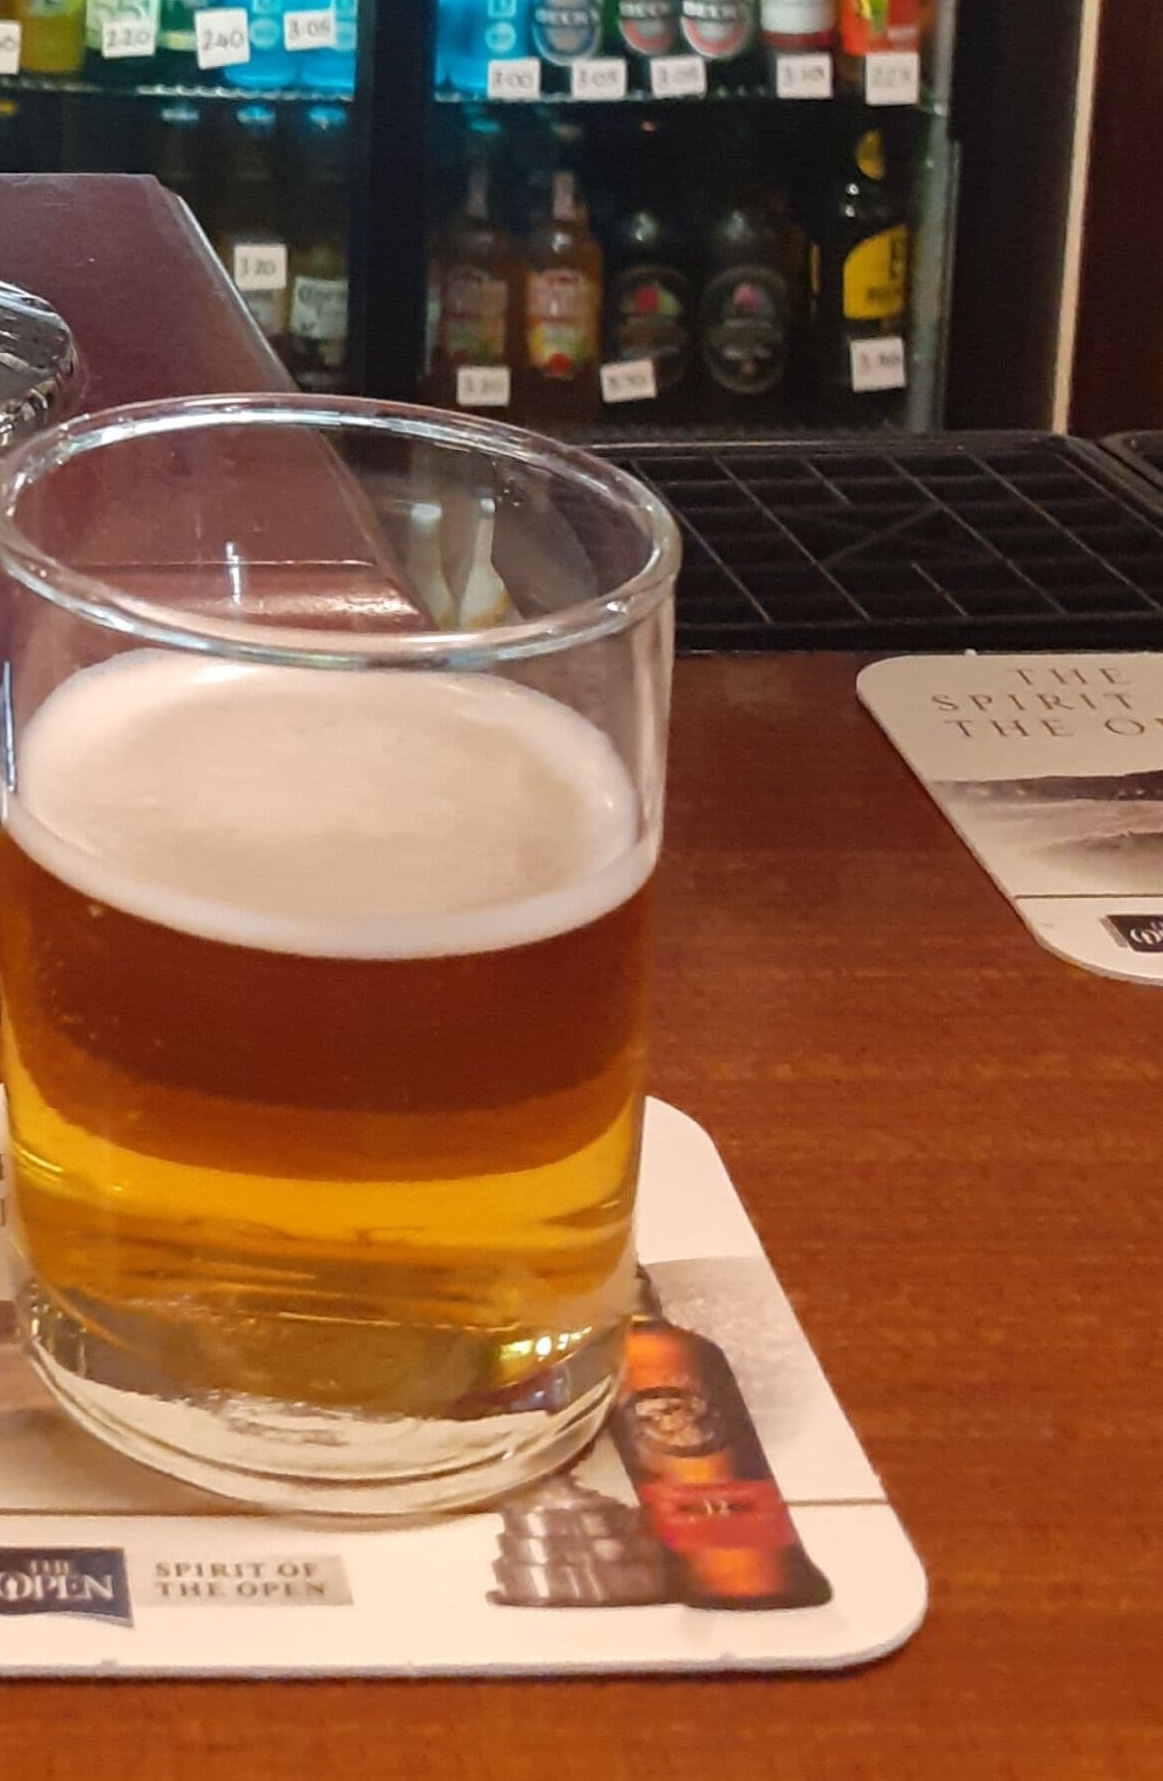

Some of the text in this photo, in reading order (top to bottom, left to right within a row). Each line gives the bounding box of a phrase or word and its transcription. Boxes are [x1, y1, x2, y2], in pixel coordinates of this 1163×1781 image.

[1014, 668, 1131, 685] THE
[931, 693, 1135, 712] SPIRIT
[944, 719, 1075, 738] THE
[154, 1561, 320, 1579] SPIRIT OF
[155, 1580, 327, 1599] THE OPEN
